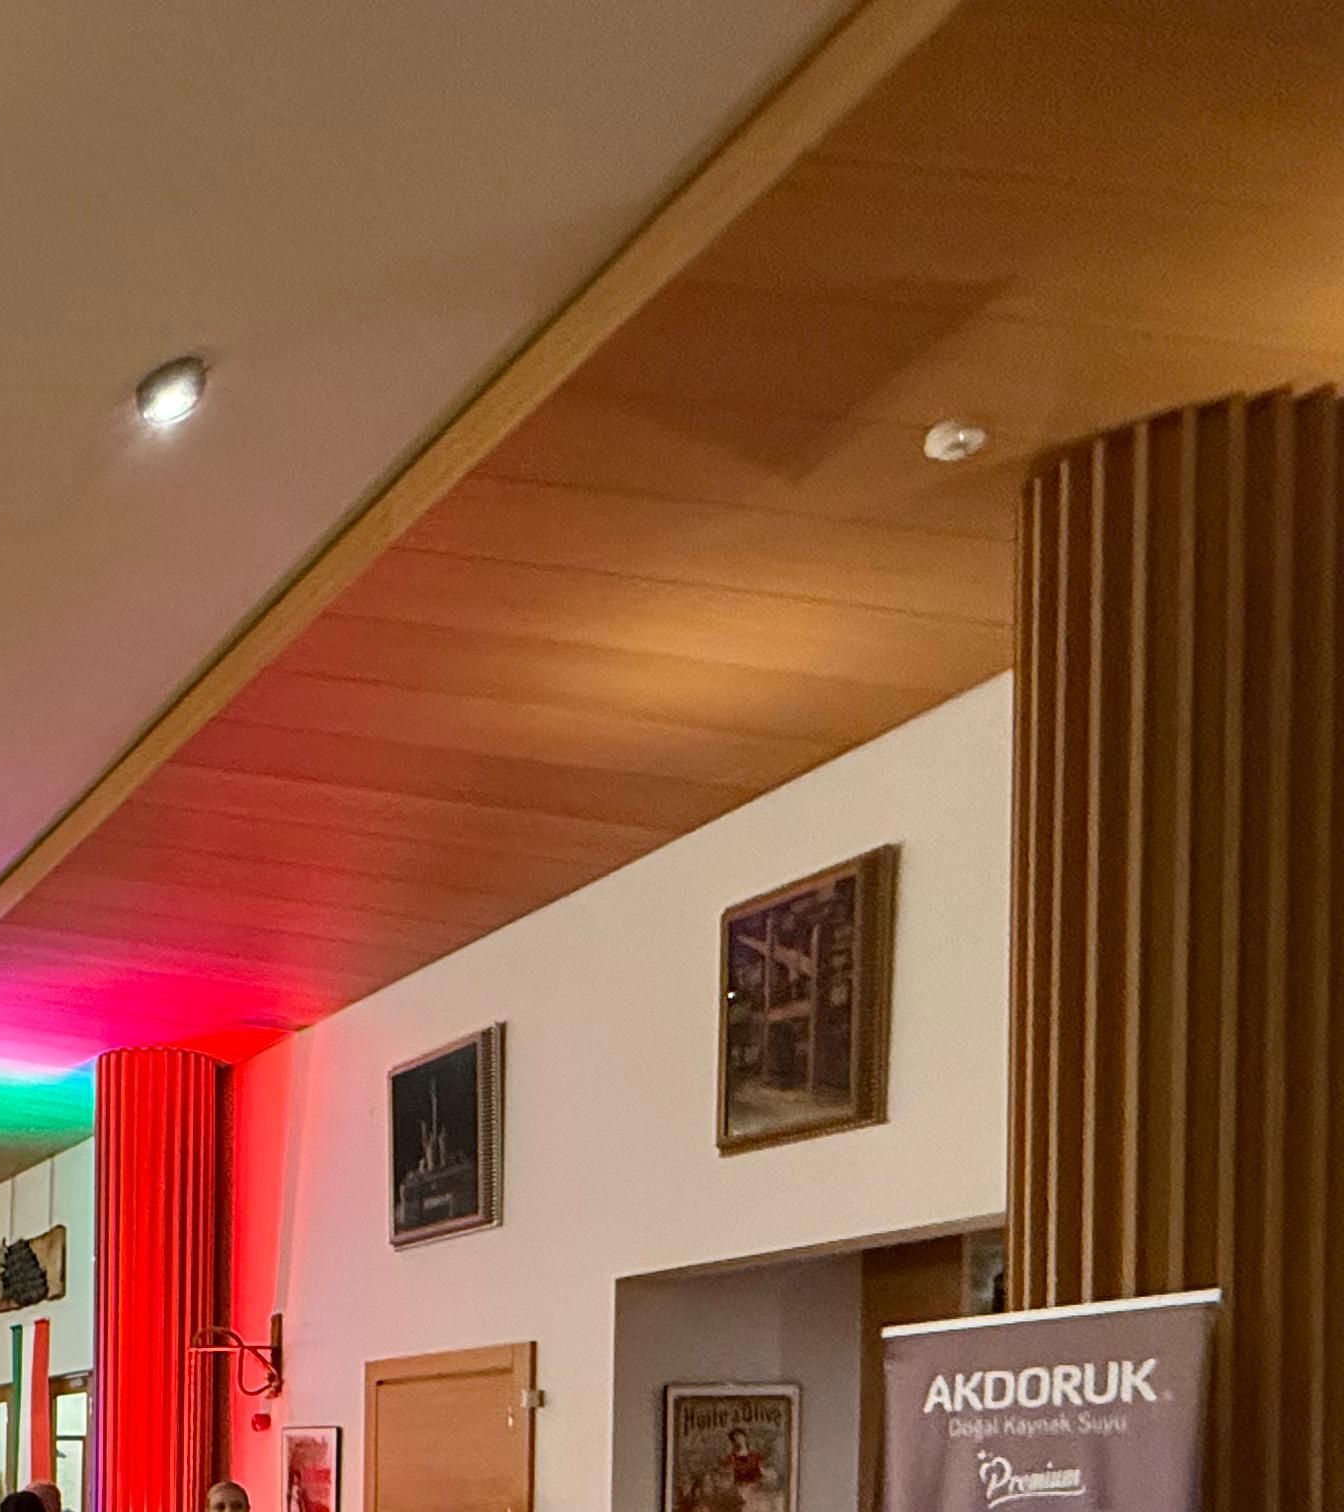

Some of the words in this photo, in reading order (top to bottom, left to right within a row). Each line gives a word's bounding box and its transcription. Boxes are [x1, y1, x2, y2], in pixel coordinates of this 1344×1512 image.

[923, 1358, 1157, 1413] AKDORUK
[1077, 1411, 1127, 1436] Suyu
[978, 1456, 1081, 1500] Premium
